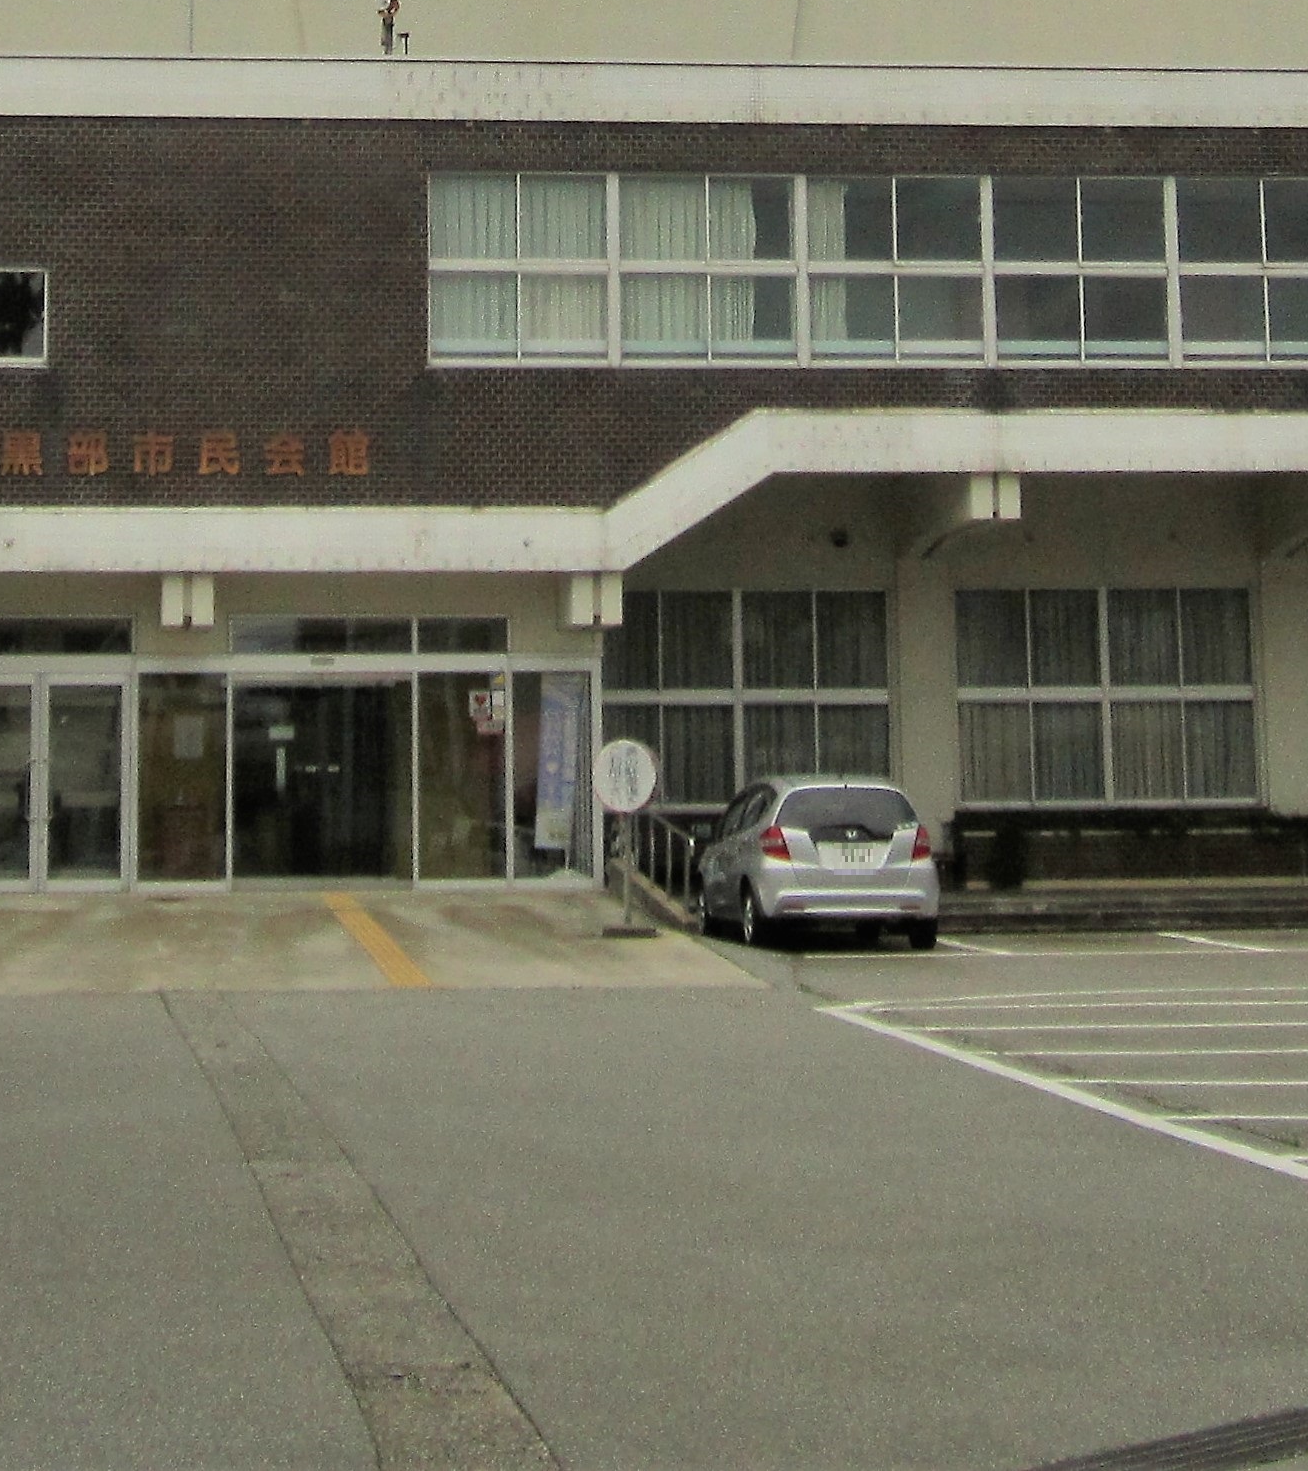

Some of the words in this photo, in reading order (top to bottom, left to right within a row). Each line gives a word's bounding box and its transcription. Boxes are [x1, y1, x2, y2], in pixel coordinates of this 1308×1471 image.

[0, 430, 370, 477] 黒部市民会館
